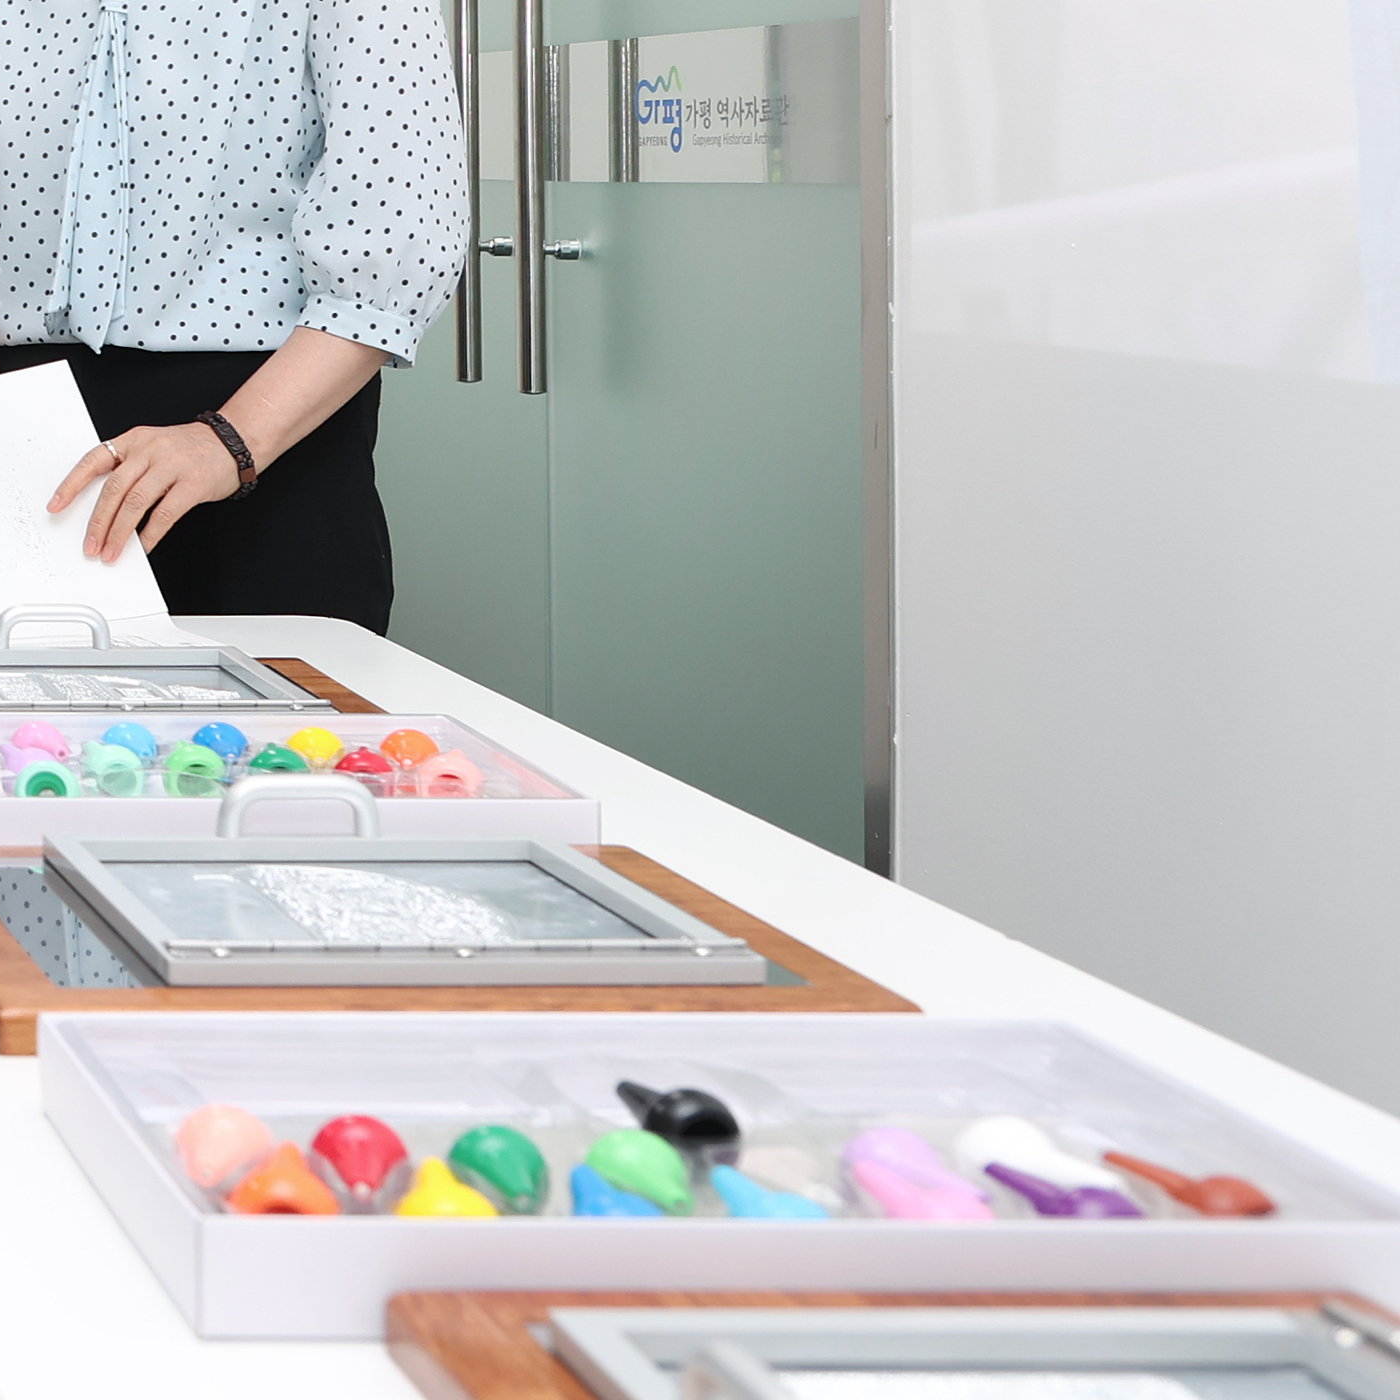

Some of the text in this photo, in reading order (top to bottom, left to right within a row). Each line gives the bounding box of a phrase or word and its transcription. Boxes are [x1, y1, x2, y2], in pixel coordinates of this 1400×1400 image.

[685, 95, 790, 130] 가평 역사자료관
[692, 135, 722, 147] Gapyeong
[723, 132, 753, 145] Historical
